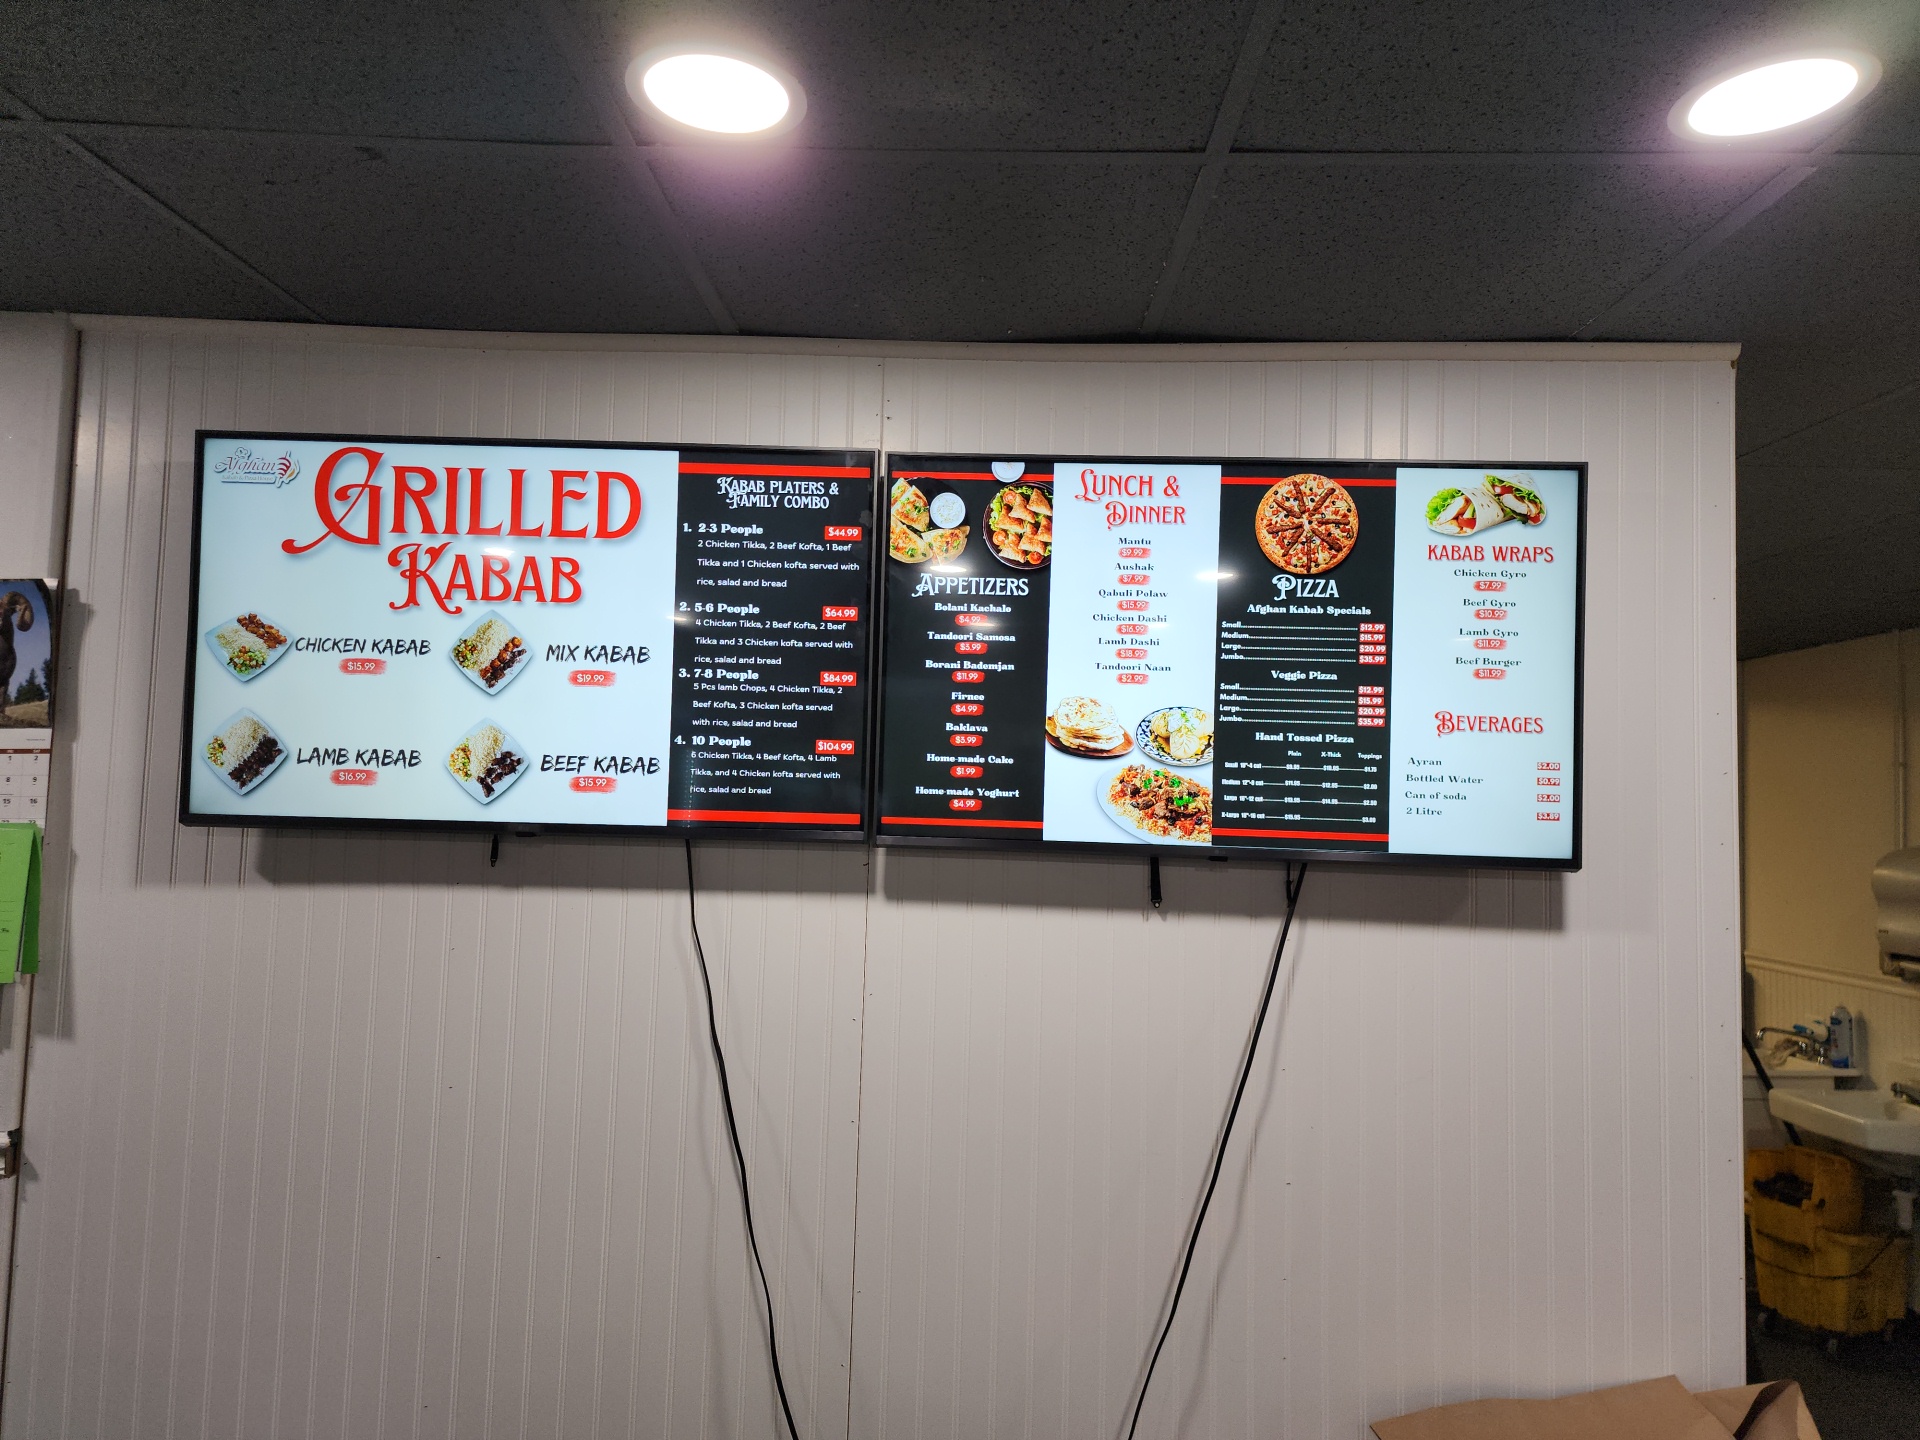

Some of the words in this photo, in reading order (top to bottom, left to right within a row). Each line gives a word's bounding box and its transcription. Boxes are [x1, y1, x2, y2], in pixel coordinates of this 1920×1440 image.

[717, 477, 765, 495] KABAB
[770, 482, 824, 494] PLATERS
[829, 483, 839, 495] &
[1075, 469, 1153, 501] LUNCH
[1163, 476, 1180, 496] &
[282, 447, 642, 555] GRILLED
[726, 491, 779, 509] FAMILY
[784, 496, 830, 508] COMBO
[1105, 501, 1186, 530] DINNER
[683, 523, 692, 532] 1.
[699, 524, 717, 533] 2-3
[721, 524, 763, 536] People
[828, 527, 859, 537] $44.99
[698, 540, 703, 548] 2
[706, 540, 740, 548] Chicken
[743, 541, 767, 549] Tikka,
[777, 542, 797, 550] Beef
[799, 543, 824, 551] Kofta,
[1428, 545, 1484, 561] KABAB
[1493, 546, 1554, 562] WRAPS
[697, 559, 720, 567] Tikka
[1115, 563, 1154, 571] Aushak
[388, 542, 582, 615] KABAB
[1454, 569, 1496, 577] Chicken
[1501, 571, 1526, 579] Gyro
[697, 578, 715, 586] rice,
[912, 573, 1029, 597] APPETIZERS
[1272, 574, 1339, 600] PIZZA
[1099, 589, 1132, 598] Qabuli
[1136, 590, 1168, 598] Polaw
[679, 602, 690, 611] 2.
[695, 603, 714, 612] 5-6
[718, 604, 760, 615] People
[935, 603, 967, 612] Bolani
[970, 603, 1011, 613] Kachalo
[1122, 601, 1145, 609] $15.99
[1491, 600, 1516, 608] Gyro
[825, 609, 855, 617] $64.99
[1247, 604, 1286, 615] Afghan
[1289, 606, 1323, 614] Kabab
[1327, 606, 1371, 616] Specials
[1093, 614, 1134, 622] Chicken
[739, 620, 763, 628] Tikka,
[794, 622, 817, 630] Kofta,
[1121, 625, 1144, 633] $16.99
[1360, 624, 1384, 632] $12.99
[927, 632, 973, 641] Tandoori
[976, 633, 1015, 641] Samosa
[1459, 628, 1488, 636] Lamb
[1493, 629, 1518, 637] Gyro
[296, 637, 365, 654] CHICKEN
[371, 639, 431, 656] KABAB
[1098, 638, 1126, 646] Lamb
[1131, 638, 1160, 646] Dashi
[546, 644, 578, 662] MIX
[584, 646, 651, 664] KABAB
[1120, 650, 1144, 658] $18.99
[1360, 645, 1386, 653] $20.99
[348, 661, 375, 671] $15.99
[926, 660, 960, 669] Borani
[964, 661, 1014, 672] Bademjan
[1095, 663, 1141, 671] Tandoori
[1145, 664, 1171, 672] Naan
[1483, 658, 1522, 667] Burger
[577, 673, 605, 683] $19.99
[679, 669, 690, 678] 3.
[694, 669, 712, 678] 7-8
[717, 670, 759, 681] People
[823, 674, 853, 682] $84.99
[1271, 670, 1306, 681] Veggie
[1309, 671, 1337, 680] Pizza
[952, 692, 984, 700] Firnee
[1358, 708, 1384, 716] $20.99
[946, 723, 988, 732] Baklava
[1435, 711, 1543, 736] BEVERAGES
[674, 736, 685, 744] 4.
[692, 736, 705, 745] 10
[709, 737, 751, 748] People
[1255, 732, 1283, 741] Hand
[1287, 733, 1322, 742] Tossed
[1325, 734, 1354, 743] Pizza
[818, 742, 852, 750] $104.99
[297, 748, 349, 765] LAMB
[356, 749, 421, 768] KABAB
[927, 754, 985, 763] Home-made
[988, 755, 1014, 764] Cake
[1408, 758, 1442, 767] Ayran
[541, 755, 588, 772] BEEF
[594, 756, 660, 774] KABAB
[1537, 762, 1559, 770] $2.00
[339, 771, 367, 781] $16.99
[1406, 774, 1443, 782] Bottled
[1448, 776, 1483, 784] Water
[579, 777, 607, 788] $15.99
[916, 787, 973, 796] Home-made
[977, 788, 1019, 798] Yoghurt
[1405, 791, 1425, 799] Can
[953, 800, 975, 808] $4.99
